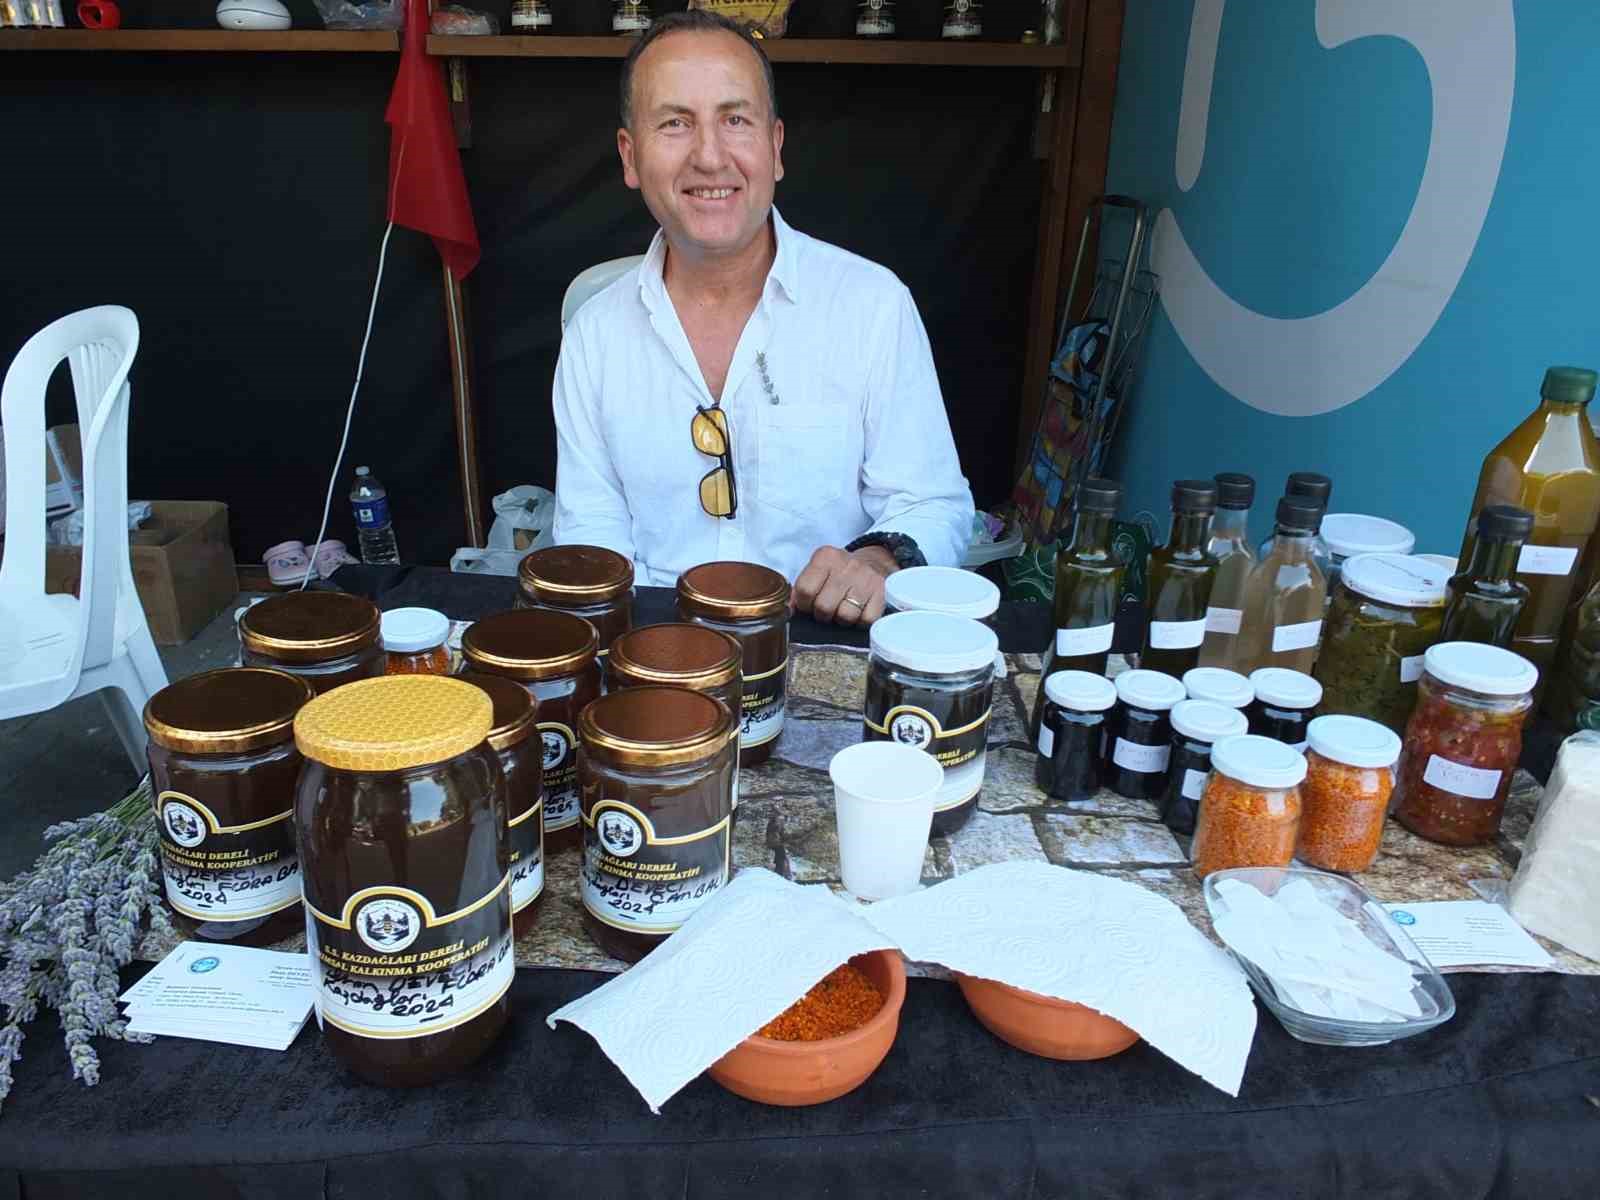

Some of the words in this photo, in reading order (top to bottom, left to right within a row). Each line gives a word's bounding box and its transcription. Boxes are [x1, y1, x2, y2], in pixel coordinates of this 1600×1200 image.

[208, 848, 249, 861] DERELİ
[341, 951, 418, 965] KAZDAĞLARI
[420, 938, 465, 961] DERELİ
[350, 963, 414, 977] KALKINMA
[415, 935, 490, 974] KOOPERATİFİ
[390, 994, 454, 1017] 2024
